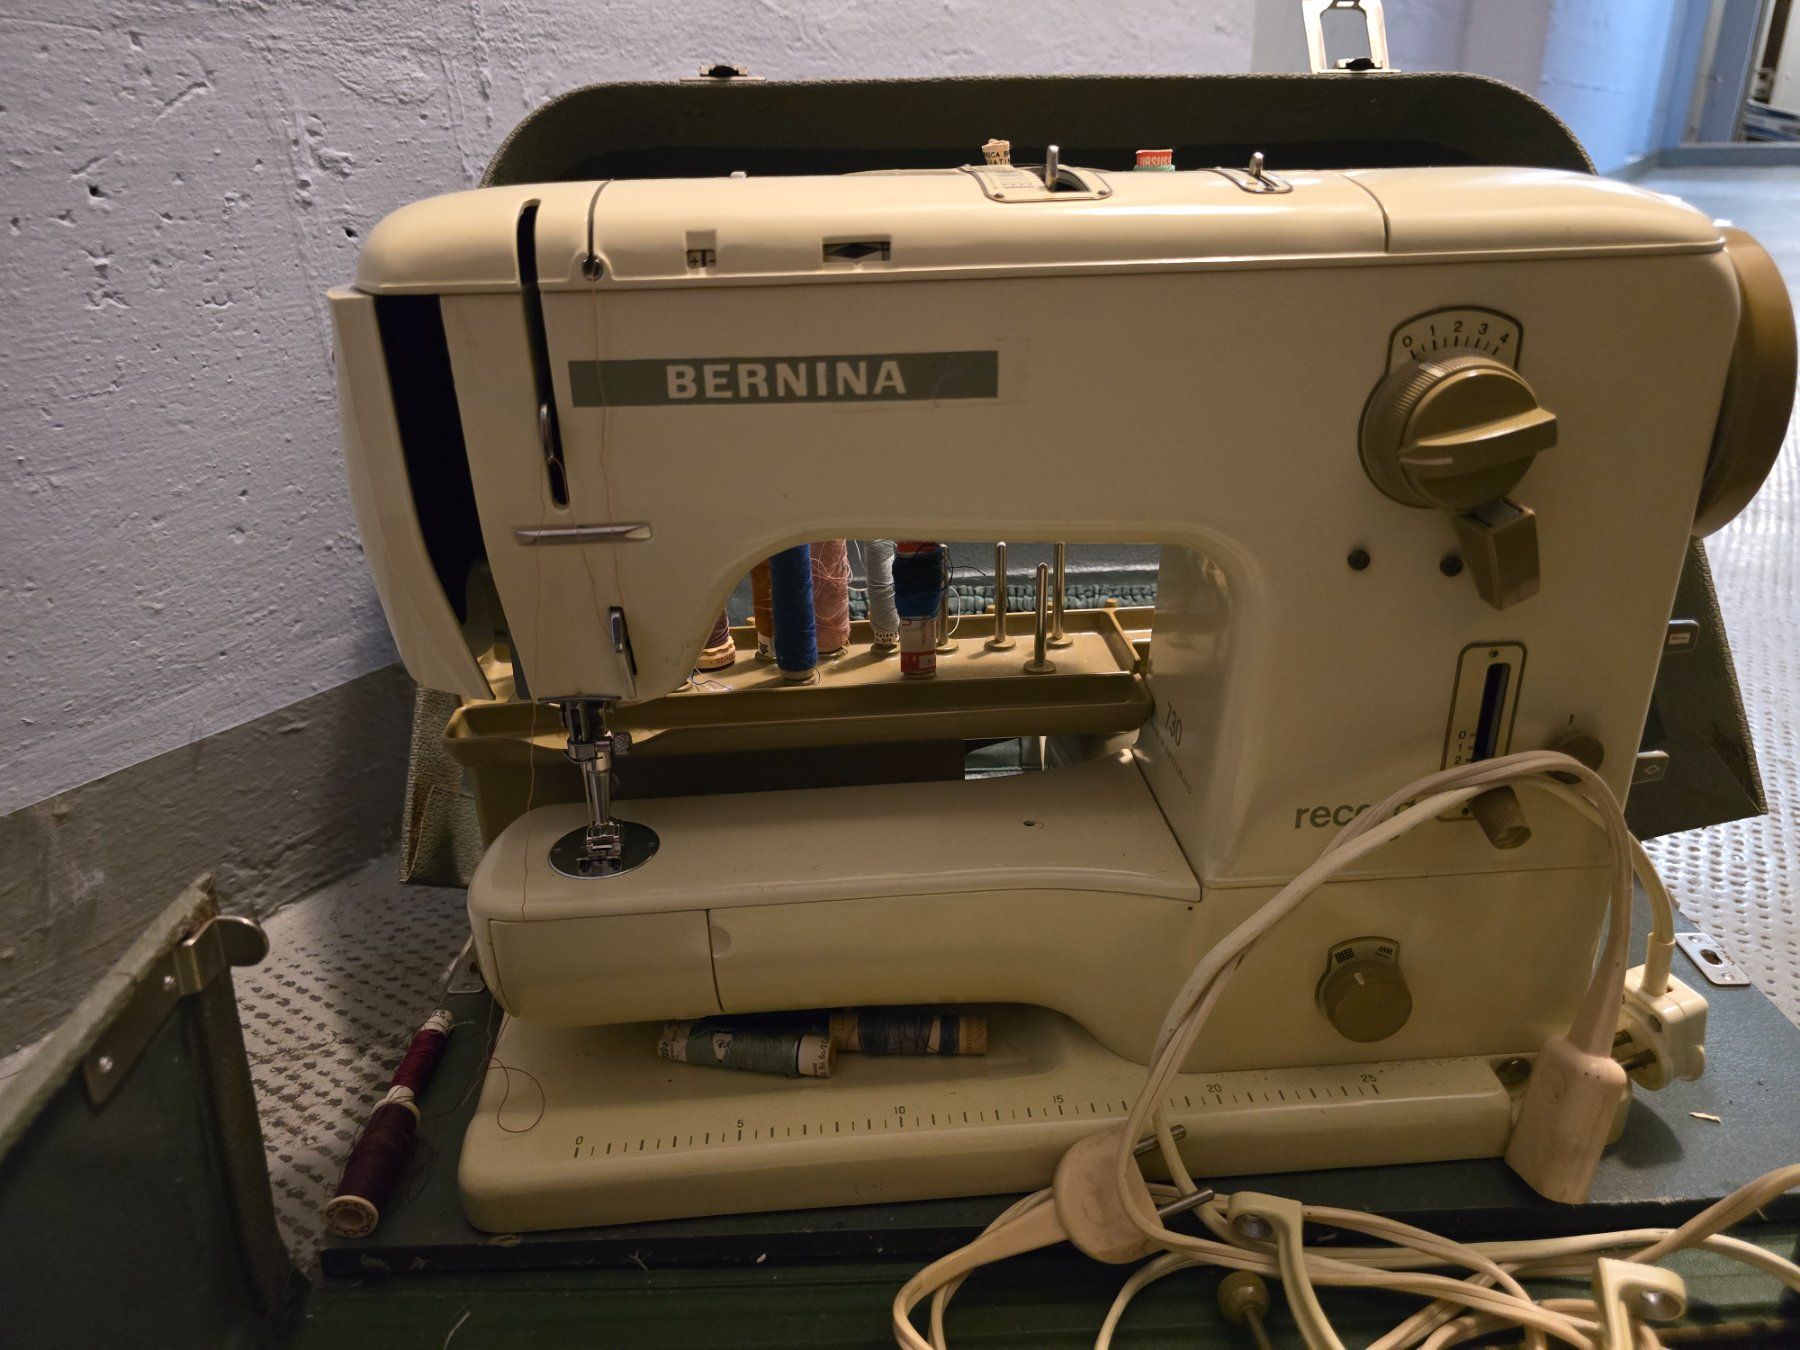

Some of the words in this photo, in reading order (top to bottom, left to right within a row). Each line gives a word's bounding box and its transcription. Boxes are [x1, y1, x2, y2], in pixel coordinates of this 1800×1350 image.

[1402, 336, 1412, 347] 0
[1430, 325, 1435, 336] 1
[1453, 321, 1463, 333] 2
[1478, 323, 1488, 335] 3
[1499, 333, 1510, 344] 4
[666, 361, 906, 399] BERNINA
[1458, 730, 1466, 739] 0
[1454, 755, 1462, 764] 2
[575, 1135, 584, 1145] 0
[736, 1119, 744, 1128] 5
[894, 1105, 905, 1115] 10
[1052, 1095, 1064, 1104] 15
[1206, 1084, 1222, 1093] 20
[1360, 1074, 1377, 1083] 25
